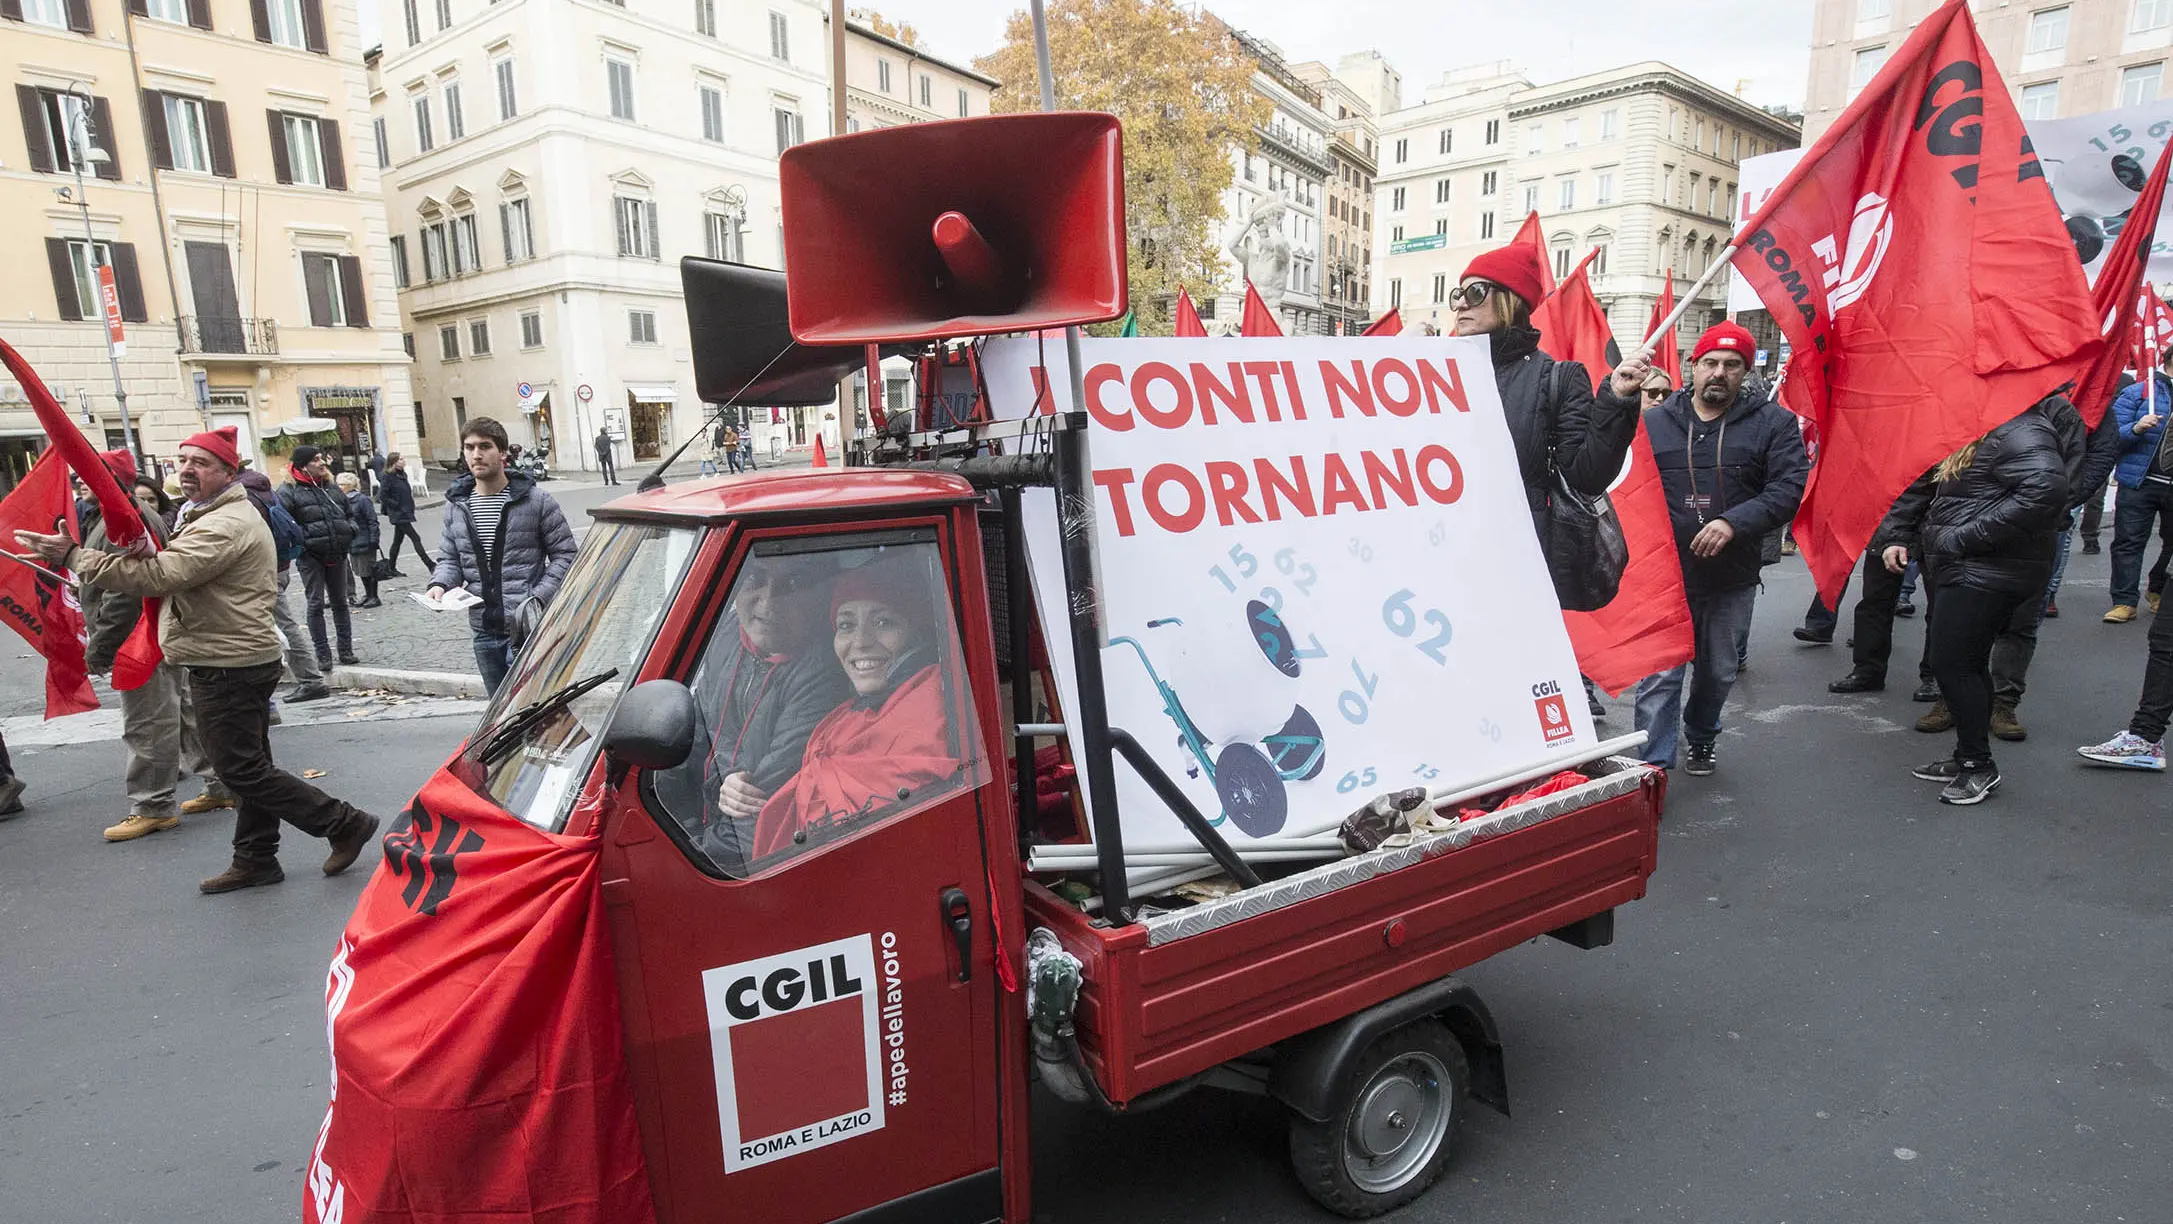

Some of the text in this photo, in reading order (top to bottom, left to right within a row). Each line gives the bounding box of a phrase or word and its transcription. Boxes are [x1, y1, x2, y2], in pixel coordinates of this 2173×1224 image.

[2088, 124, 2132, 152] 15
[1748, 229, 1816, 328] ROMA
[1758, 350, 1766, 360] P
[1083, 360, 1308, 432] CONTI
[1318, 357, 1471, 419] NON
[1092, 444, 1465, 537] TORNANO
[1208, 544, 1258, 594] 15
[1274, 547, 1317, 596] 62
[1348, 537, 1373, 563] 30
[1, 596, 43, 636] ROMA
[1382, 588, 1453, 666] 62
[1532, 680, 1561, 697] CGIL
[1479, 717, 1502, 743] 30
[1547, 726, 1568, 737] FILLEA
[1337, 766, 1378, 793] 65
[725, 954, 862, 1020] CGIL
[880, 931, 909, 1107] #apedellavoro
[740, 1112, 872, 1161] ROMA E LAZIO
